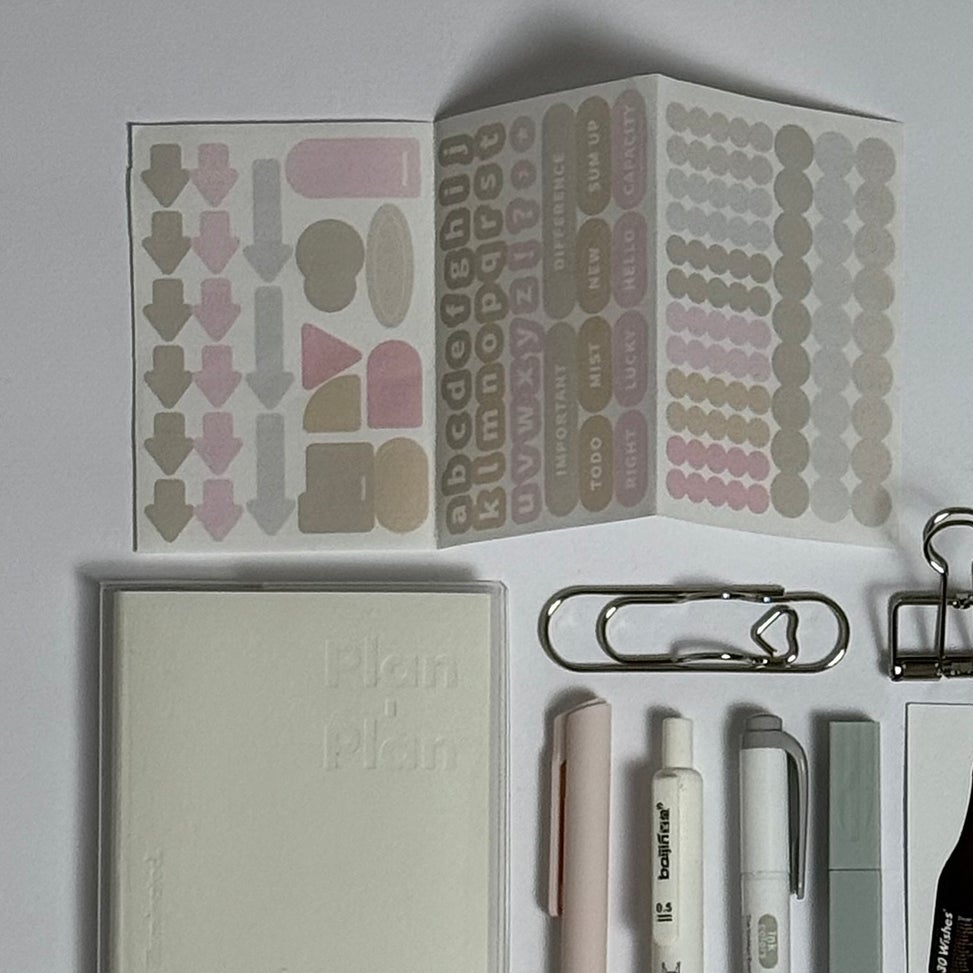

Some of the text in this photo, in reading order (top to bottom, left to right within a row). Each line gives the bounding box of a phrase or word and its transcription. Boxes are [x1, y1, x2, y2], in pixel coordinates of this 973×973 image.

[587, 119, 600, 194] SUM UP
[623, 103, 636, 197] CAPACITY
[553, 153, 566, 272] DIFFERENCE
[588, 246, 601, 290] NEW
[624, 231, 637, 289] HELLO
[589, 340, 602, 388] MIST
[624, 330, 637, 389] LUCKY
[555, 362, 569, 475] IMPORTANT
[590, 435, 604, 491] TODO
[624, 428, 637, 490] RIGHT
